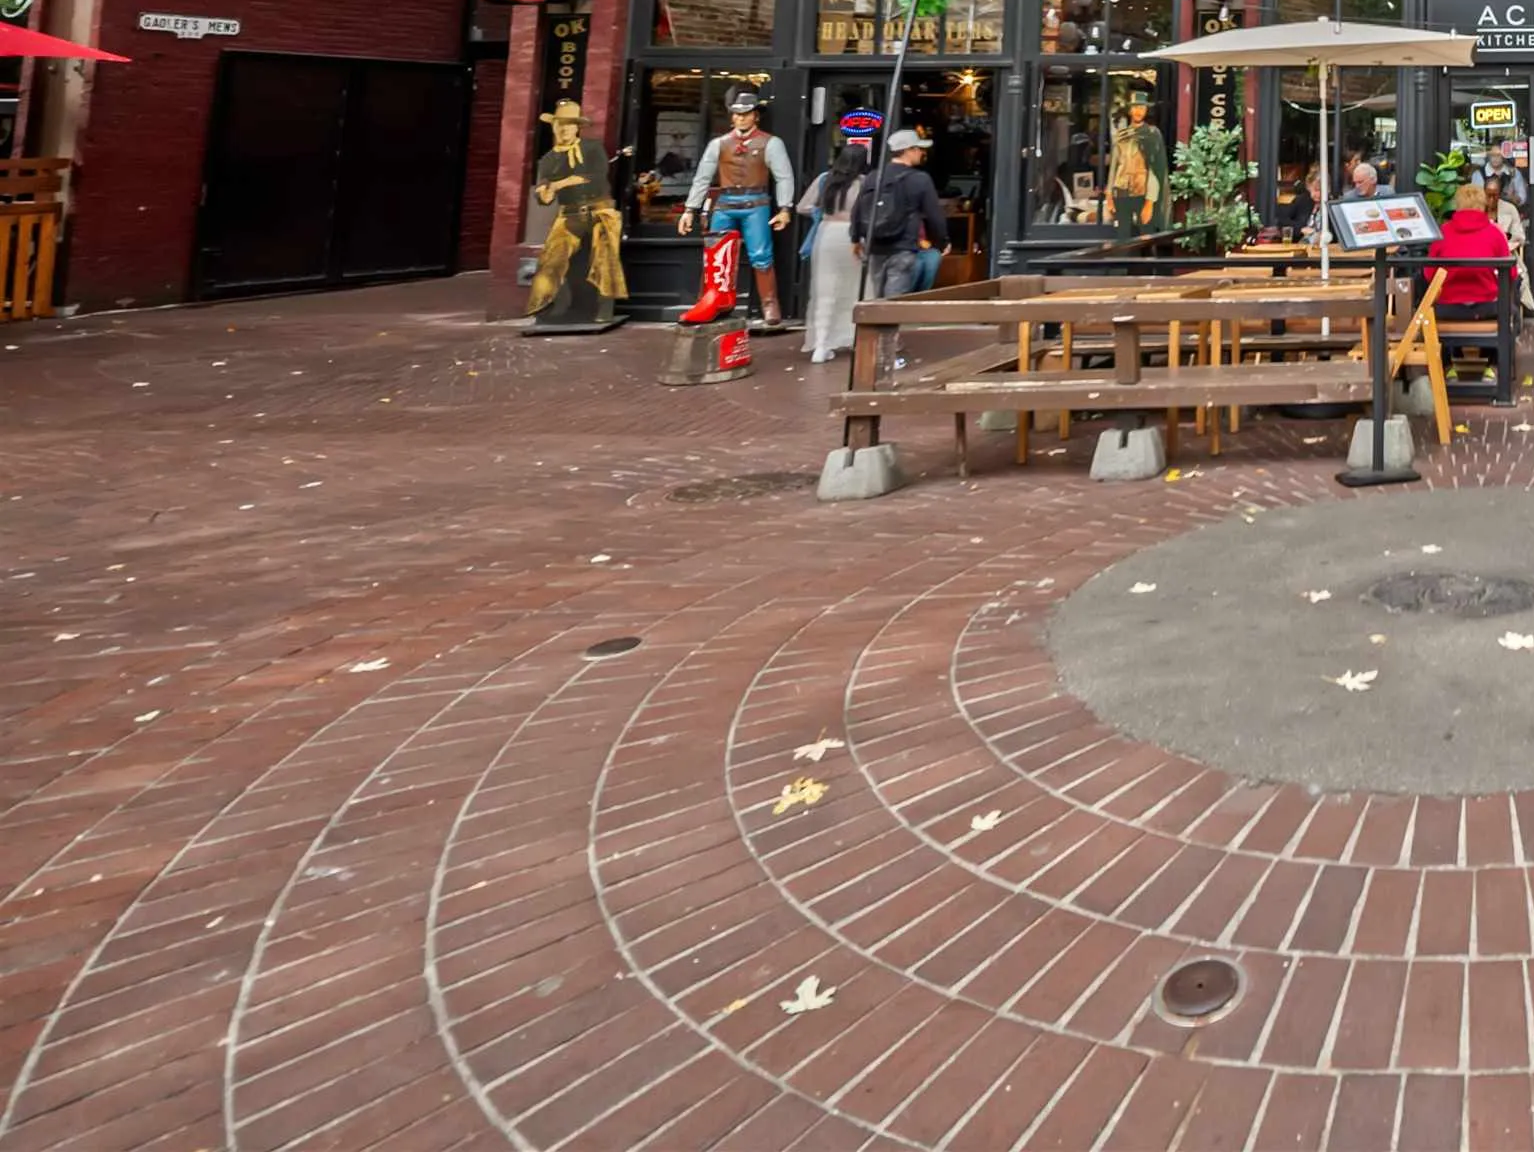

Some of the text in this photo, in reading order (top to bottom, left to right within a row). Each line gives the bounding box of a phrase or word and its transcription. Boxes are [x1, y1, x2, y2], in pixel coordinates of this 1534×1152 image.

[553, 17, 587, 39] OK
[1204, 13, 1237, 34] OK
[558, 41, 577, 89] BOOT
[840, 114, 884, 129] OPEN
[1475, 107, 1512, 122] OPEN
